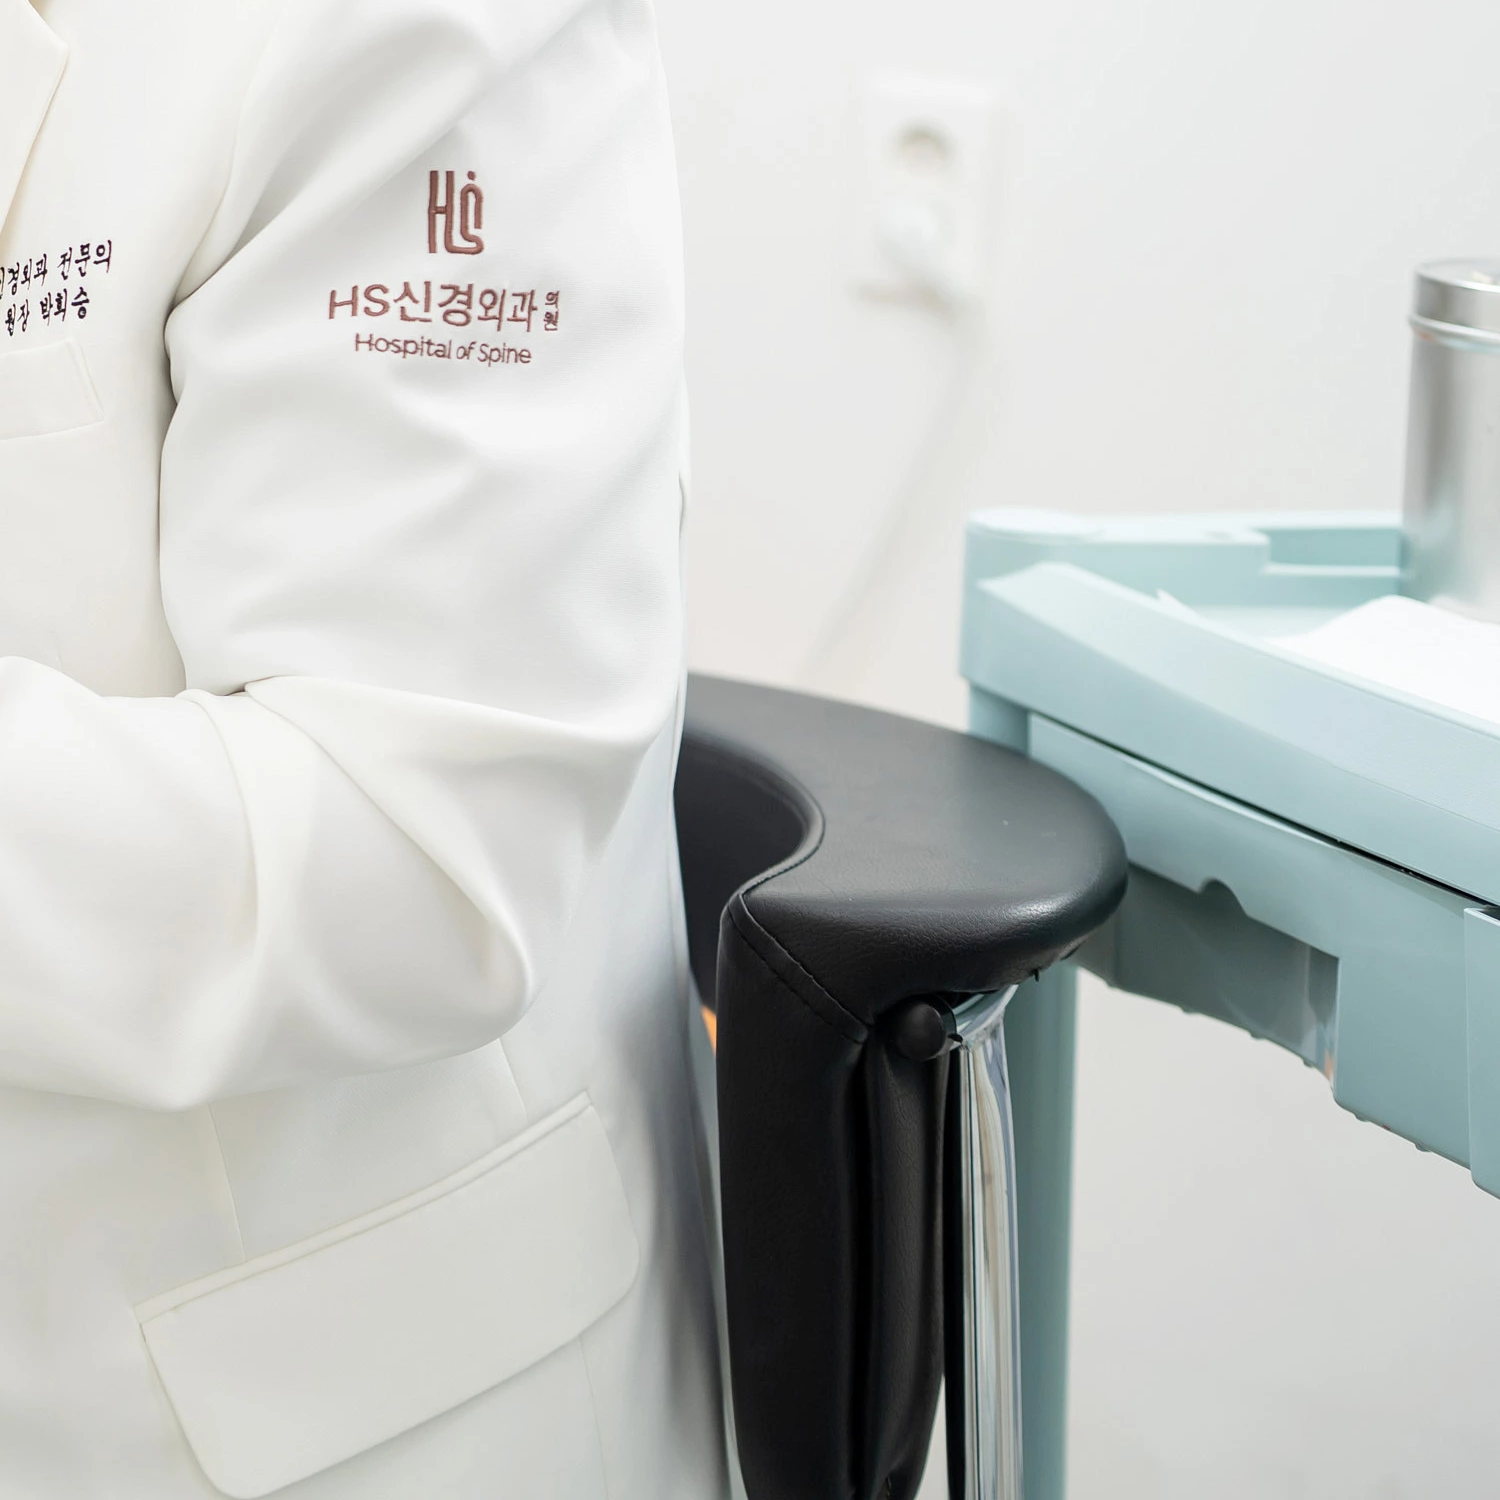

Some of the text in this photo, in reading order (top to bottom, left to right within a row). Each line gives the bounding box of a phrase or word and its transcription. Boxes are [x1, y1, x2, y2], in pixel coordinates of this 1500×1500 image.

[57, 239, 112, 280] 전문의
[5, 299, 30, 337] 원장
[328, 280, 539, 333] HS신경외과
[354, 333, 532, 367] Hospital of Spine
